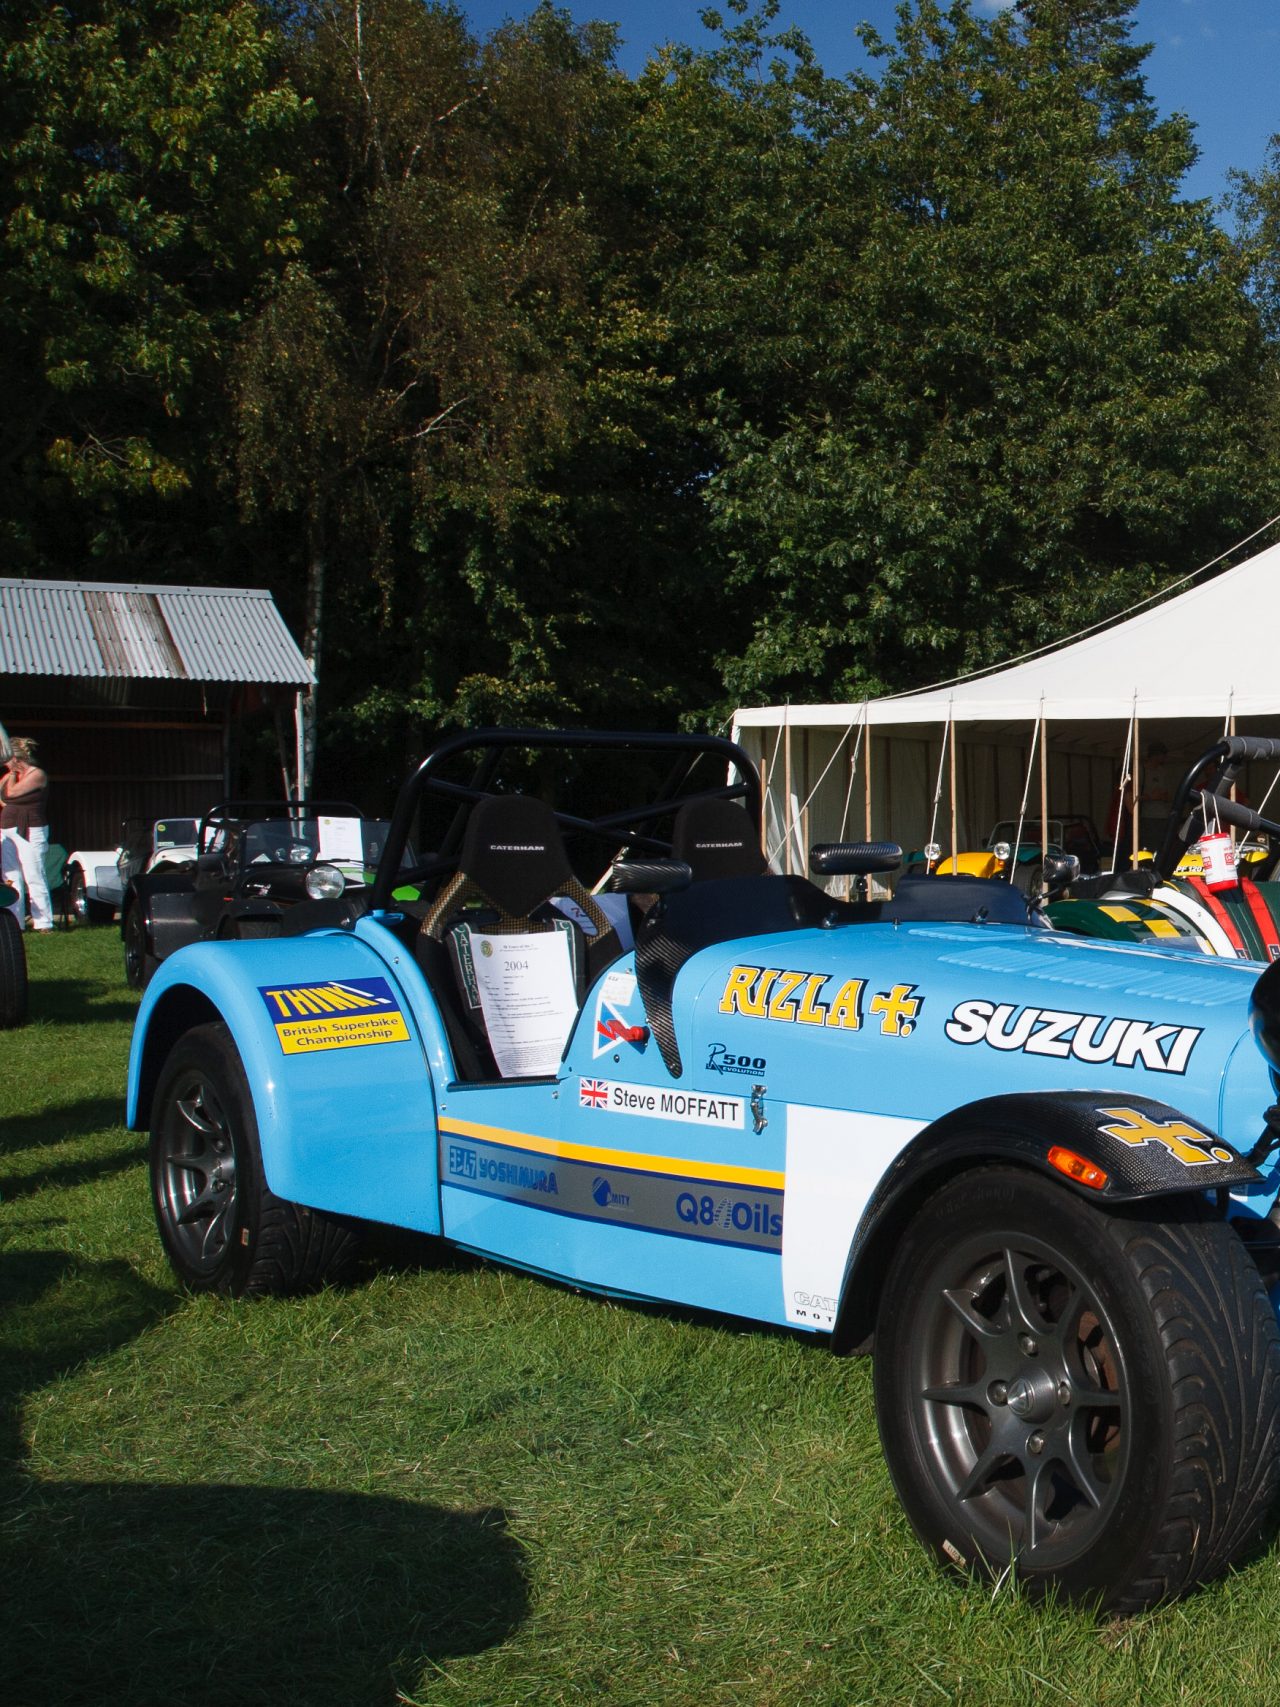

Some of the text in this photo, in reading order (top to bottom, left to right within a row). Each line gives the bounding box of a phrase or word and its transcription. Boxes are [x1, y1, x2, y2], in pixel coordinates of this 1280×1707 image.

[504, 960, 529, 971] 2004
[265, 981, 392, 1018] THINK!
[719, 964, 863, 1031] RIZLA
[283, 1018, 399, 1037] British Superbike
[297, 1029, 393, 1047] Championship
[946, 1000, 1204, 1076] SUZUKI
[613, 1087, 739, 1122] Steve MOFFATT
[479, 1157, 559, 1195] YOSHIMURA
[676, 1192, 782, 1237] Q8 Oils
